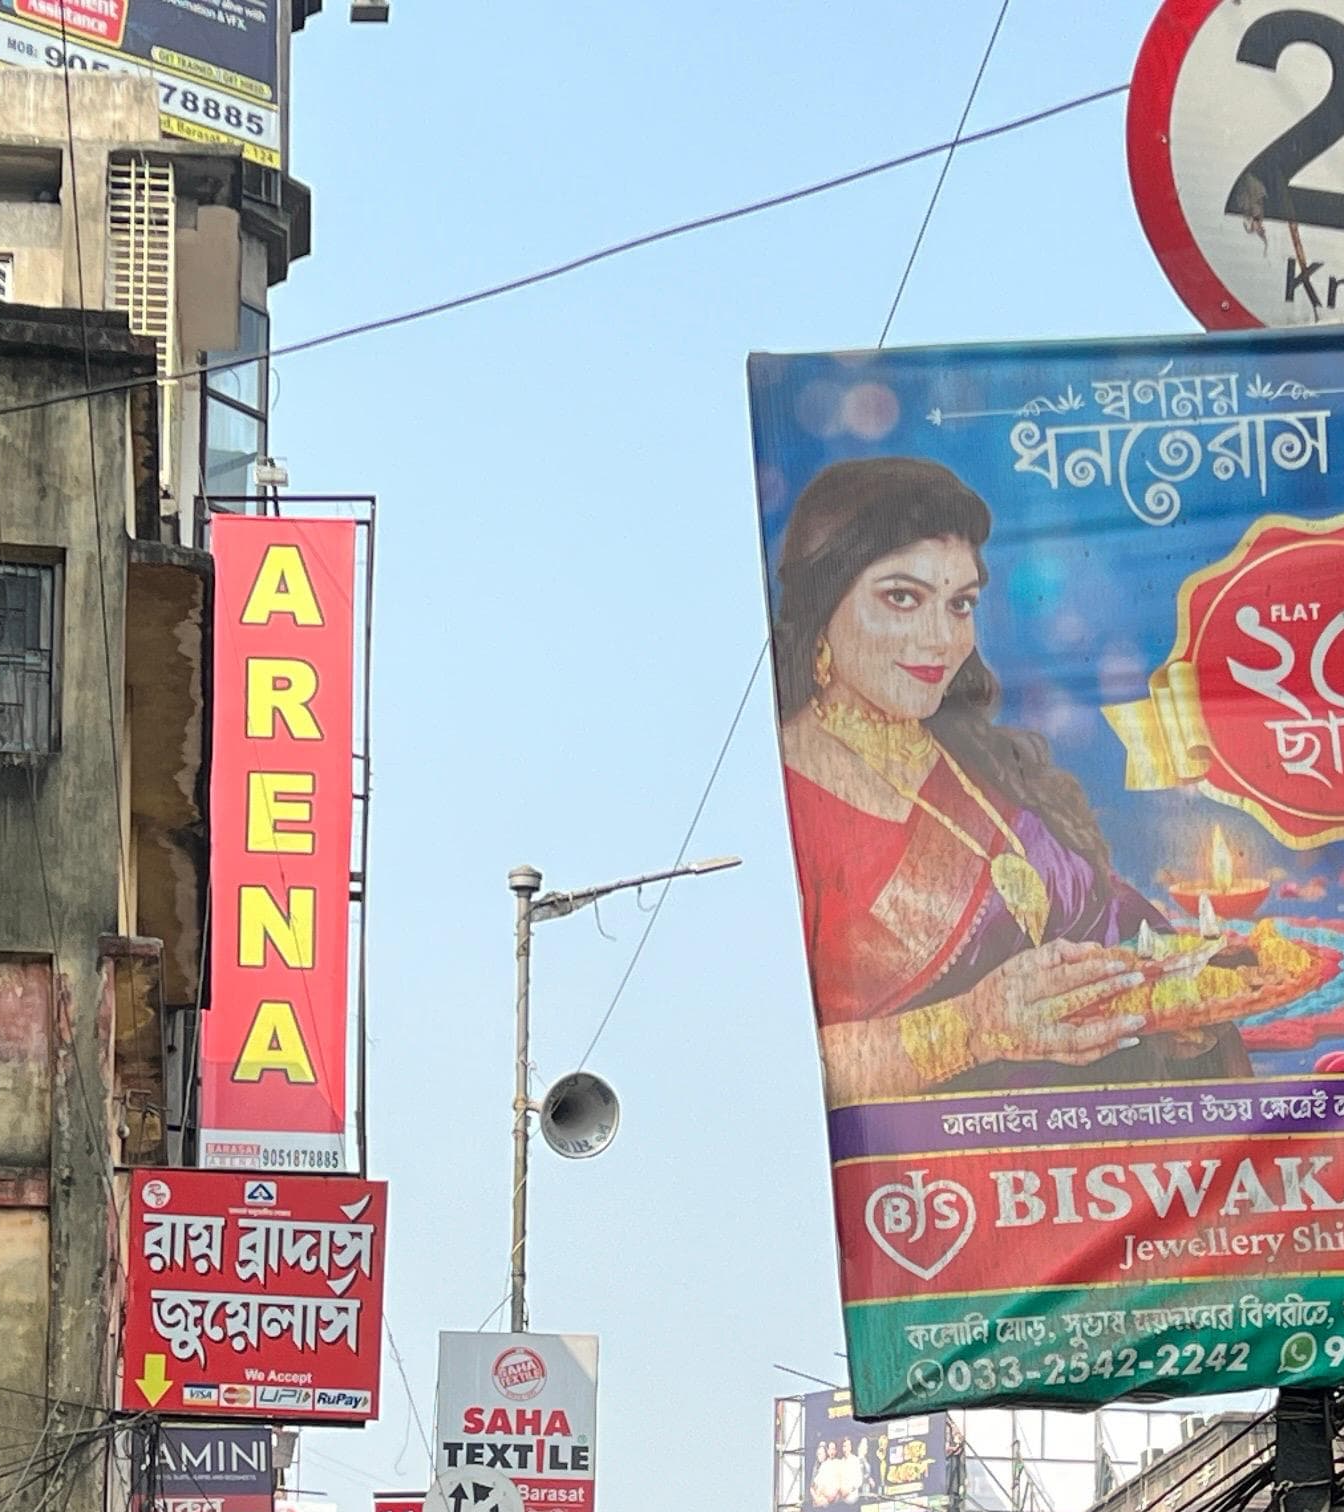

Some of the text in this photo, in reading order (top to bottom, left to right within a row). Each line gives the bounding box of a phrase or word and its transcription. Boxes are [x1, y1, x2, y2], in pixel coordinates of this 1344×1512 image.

[1010, 410, 1330, 525] ধনতেরাস
[1270, 602, 1321, 622] FLAT
[231, 543, 325, 1083] ARENA
[942, 1105, 1038, 1136] অনলাইন
[1046, 1107, 1093, 1131] এবং
[262, 1148, 339, 1169] 9051878885
[144, 1213, 225, 1273] রায়
[1121, 1231, 1286, 1269] Jewellery
[150, 1268, 362, 1369] জুয়েলার্স
[268, 1371, 313, 1385] Accept
[947, 1341, 1250, 1392] 033-2542-2242
[317, 1393, 362, 1408] RuPay
[462, 1406, 573, 1438] SAHA
[442, 1437, 590, 1474] TEXTILE
[517, 1484, 586, 1503] Barasat
